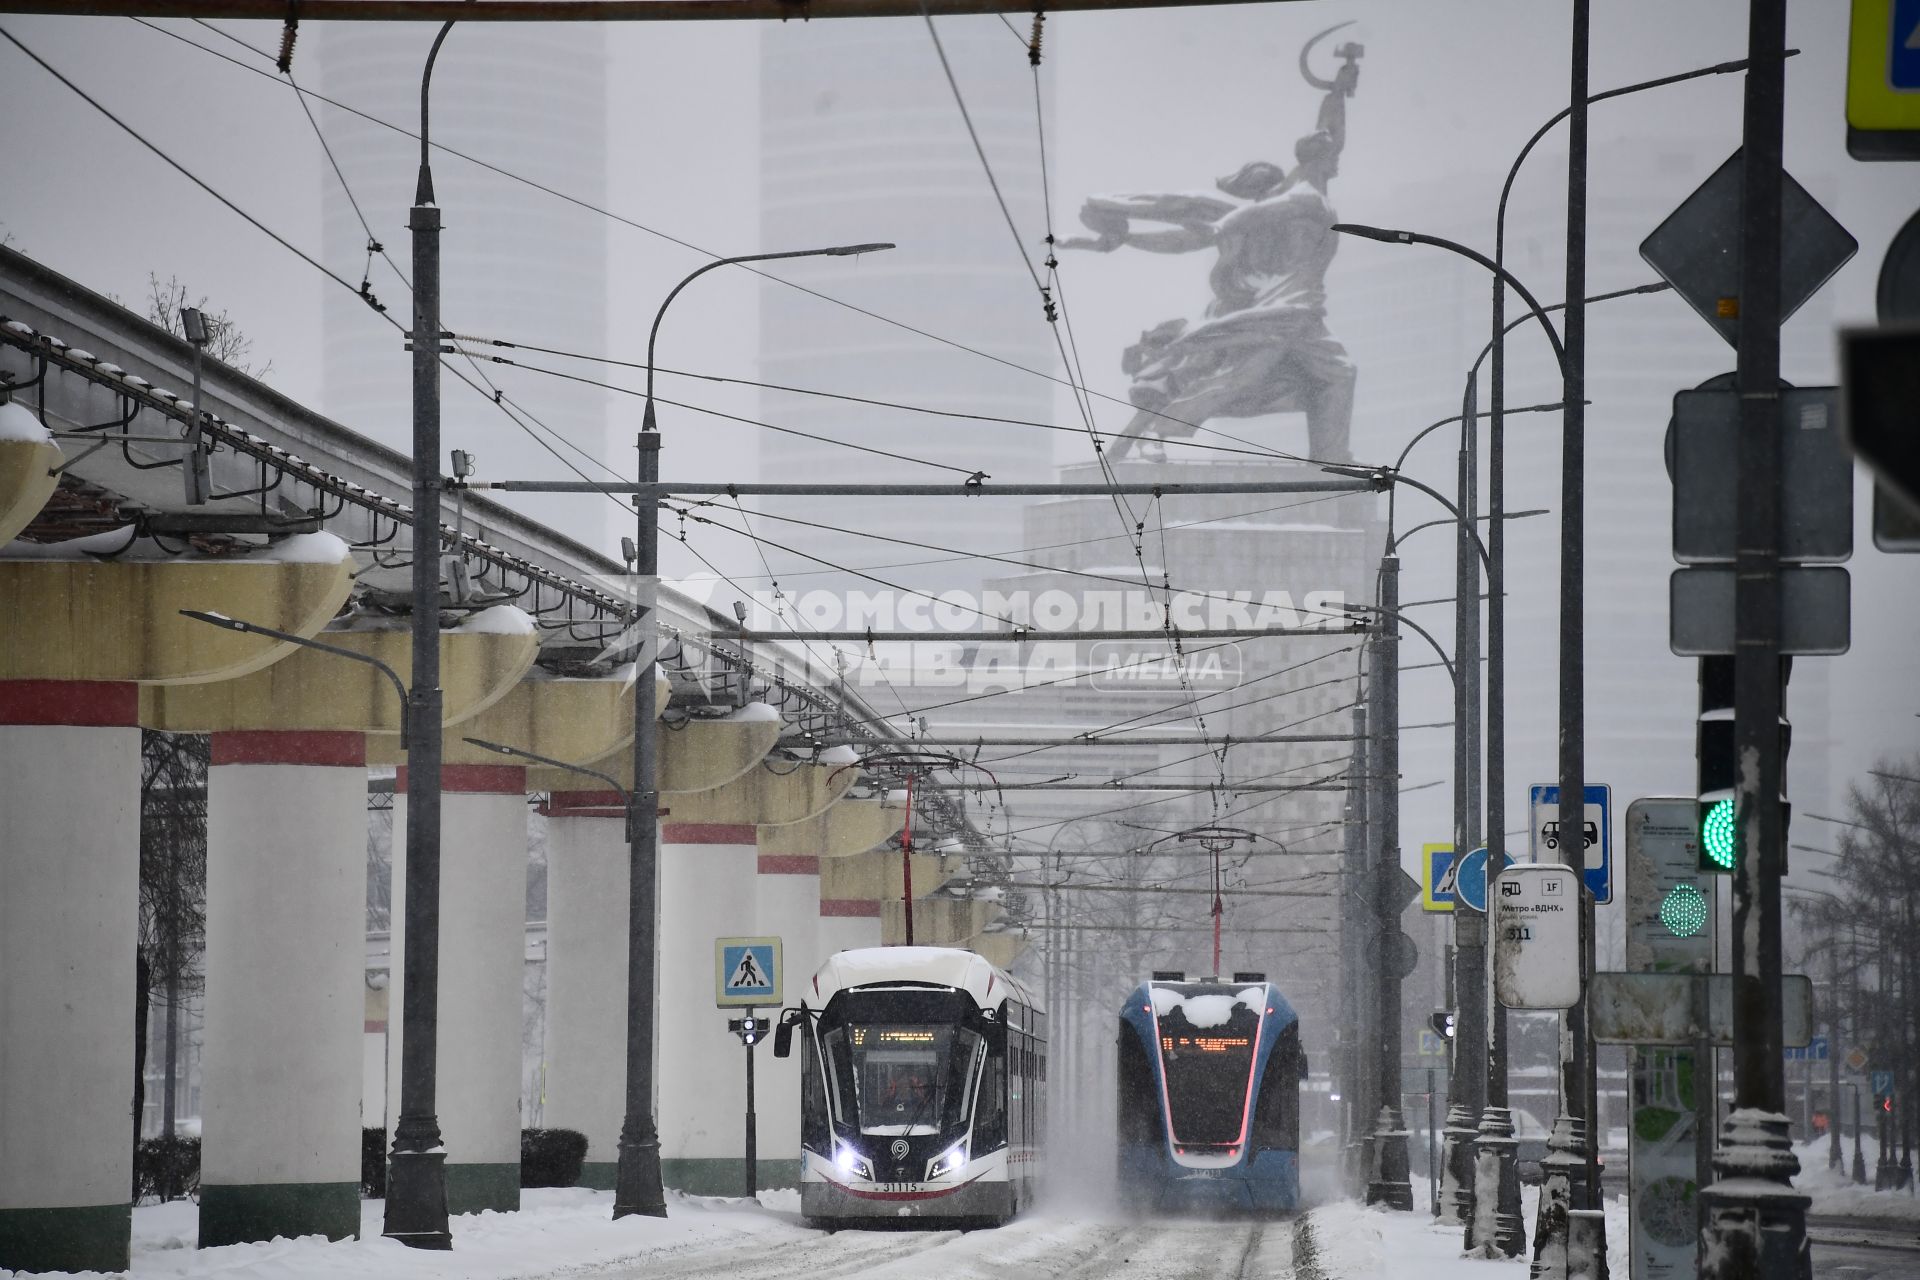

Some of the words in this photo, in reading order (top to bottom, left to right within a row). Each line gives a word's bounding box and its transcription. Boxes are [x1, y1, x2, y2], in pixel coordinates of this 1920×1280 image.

[1502, 904, 1530, 913] Метро
[1531, 904, 1564, 913] «ВДНХ»
[883, 1183, 917, 1192] 31115
